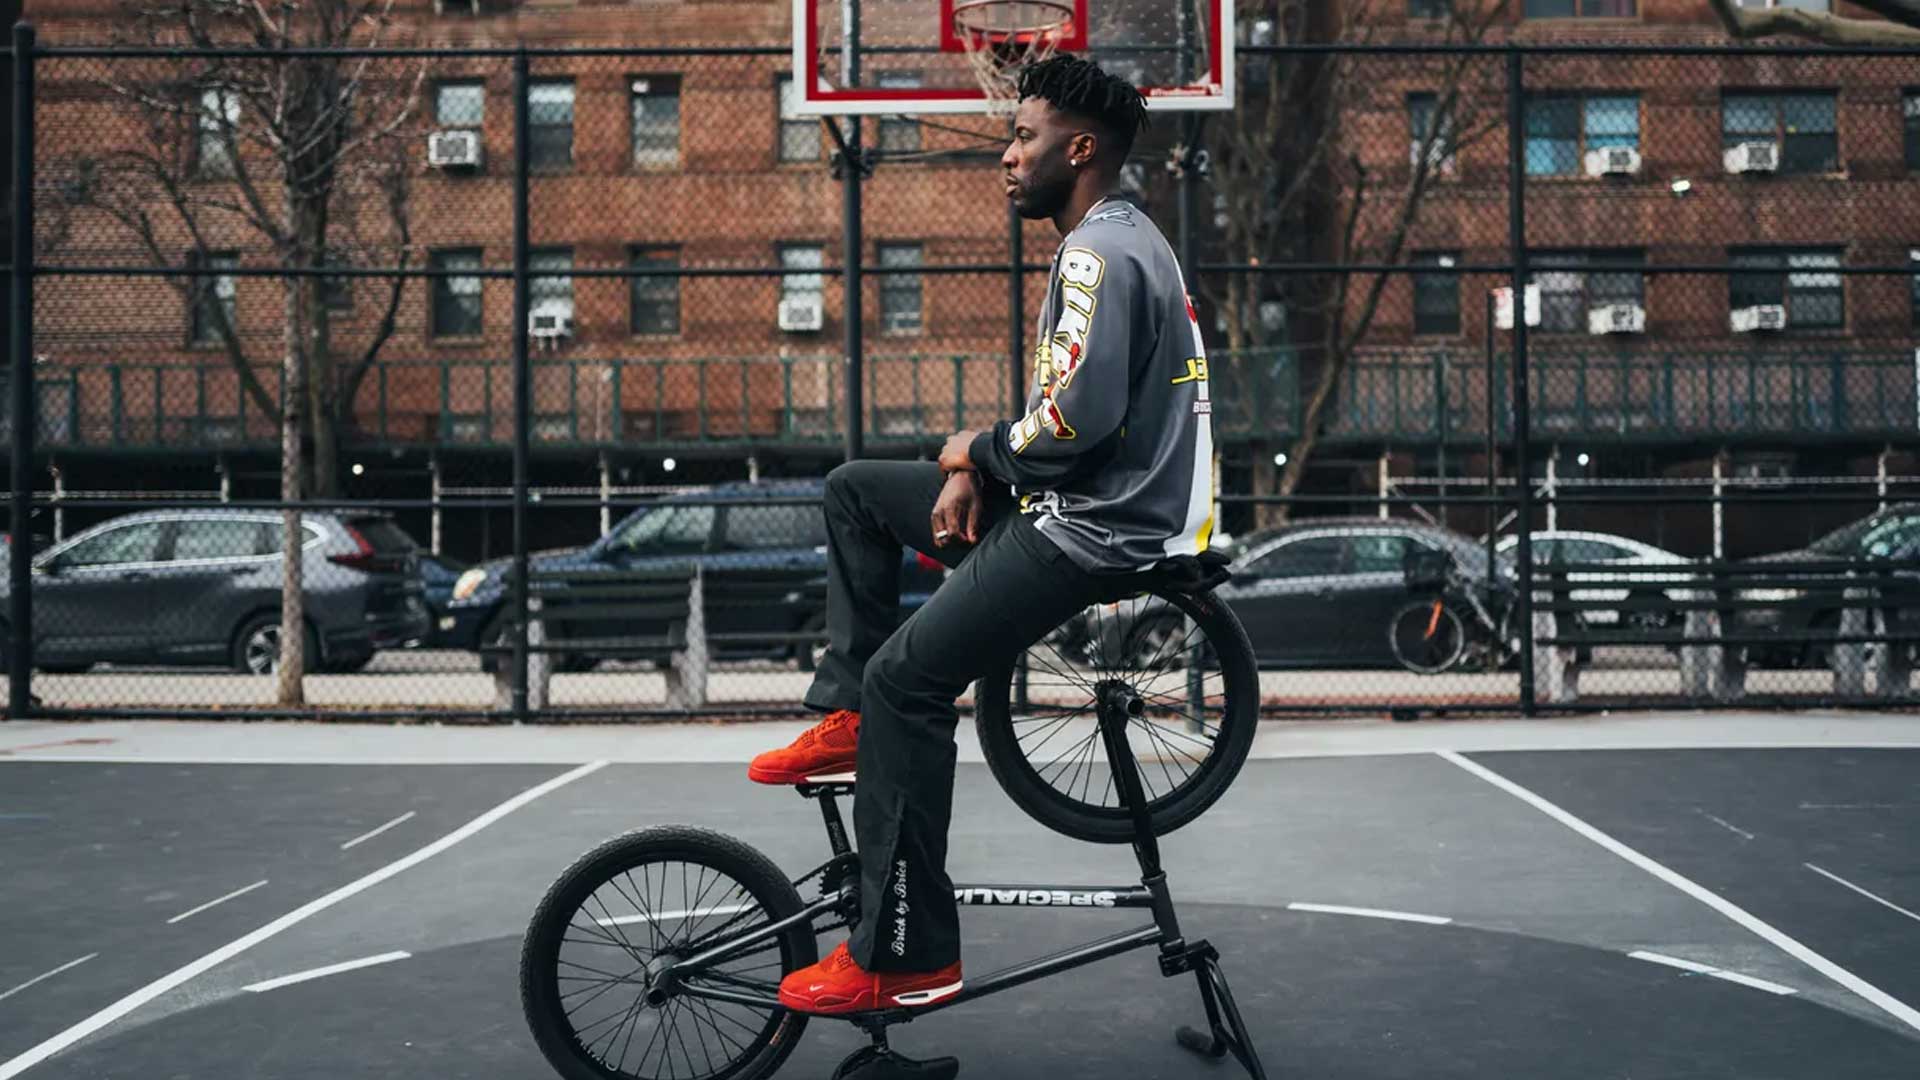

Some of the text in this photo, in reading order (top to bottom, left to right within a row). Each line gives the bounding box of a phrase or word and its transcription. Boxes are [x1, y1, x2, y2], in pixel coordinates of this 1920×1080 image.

[891, 859, 910, 957] Brick by Brick
